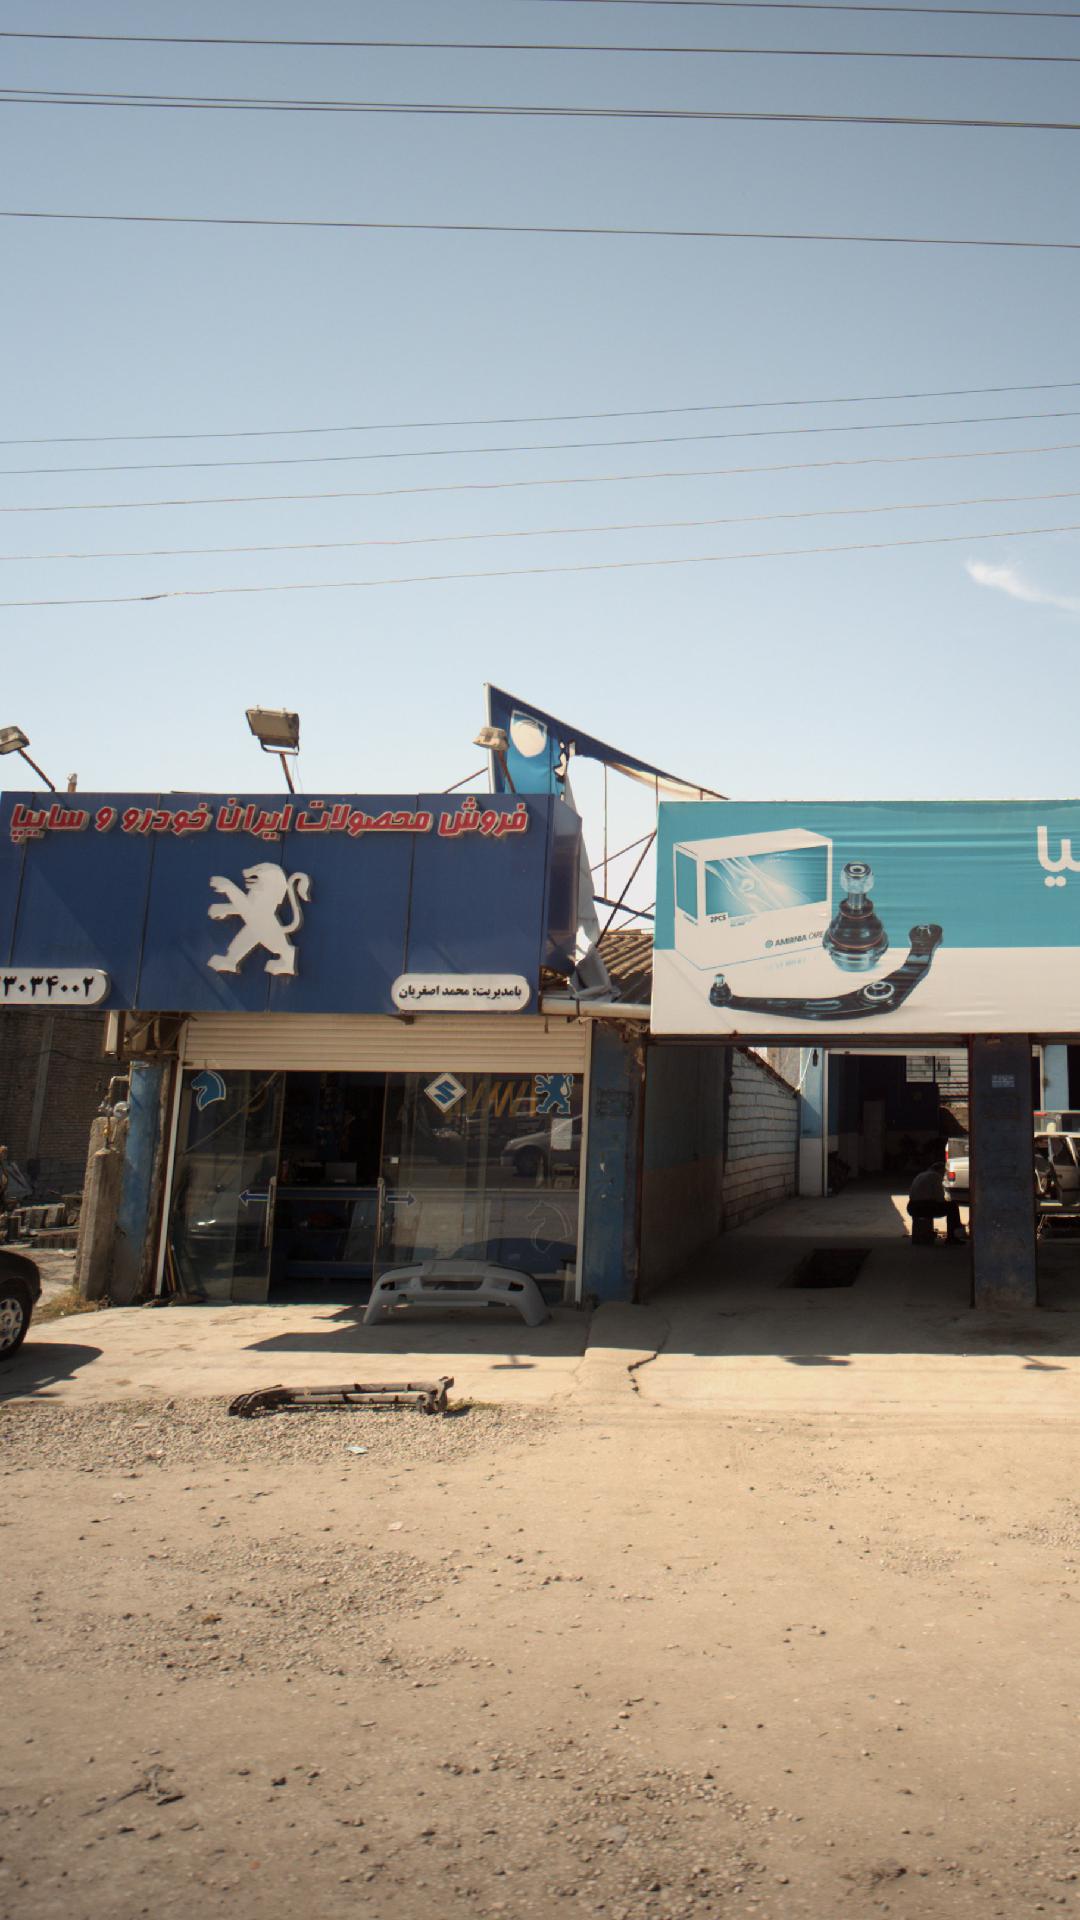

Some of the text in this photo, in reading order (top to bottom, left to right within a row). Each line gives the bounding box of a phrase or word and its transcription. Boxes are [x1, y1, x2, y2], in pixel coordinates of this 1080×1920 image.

[10, 796, 530, 843] فروش محصولات ایران خودرو و سایپا
[0, 975, 95, 998] ۳۰۳۴۰۰۲
[442, 986, 470, 997] محمد
